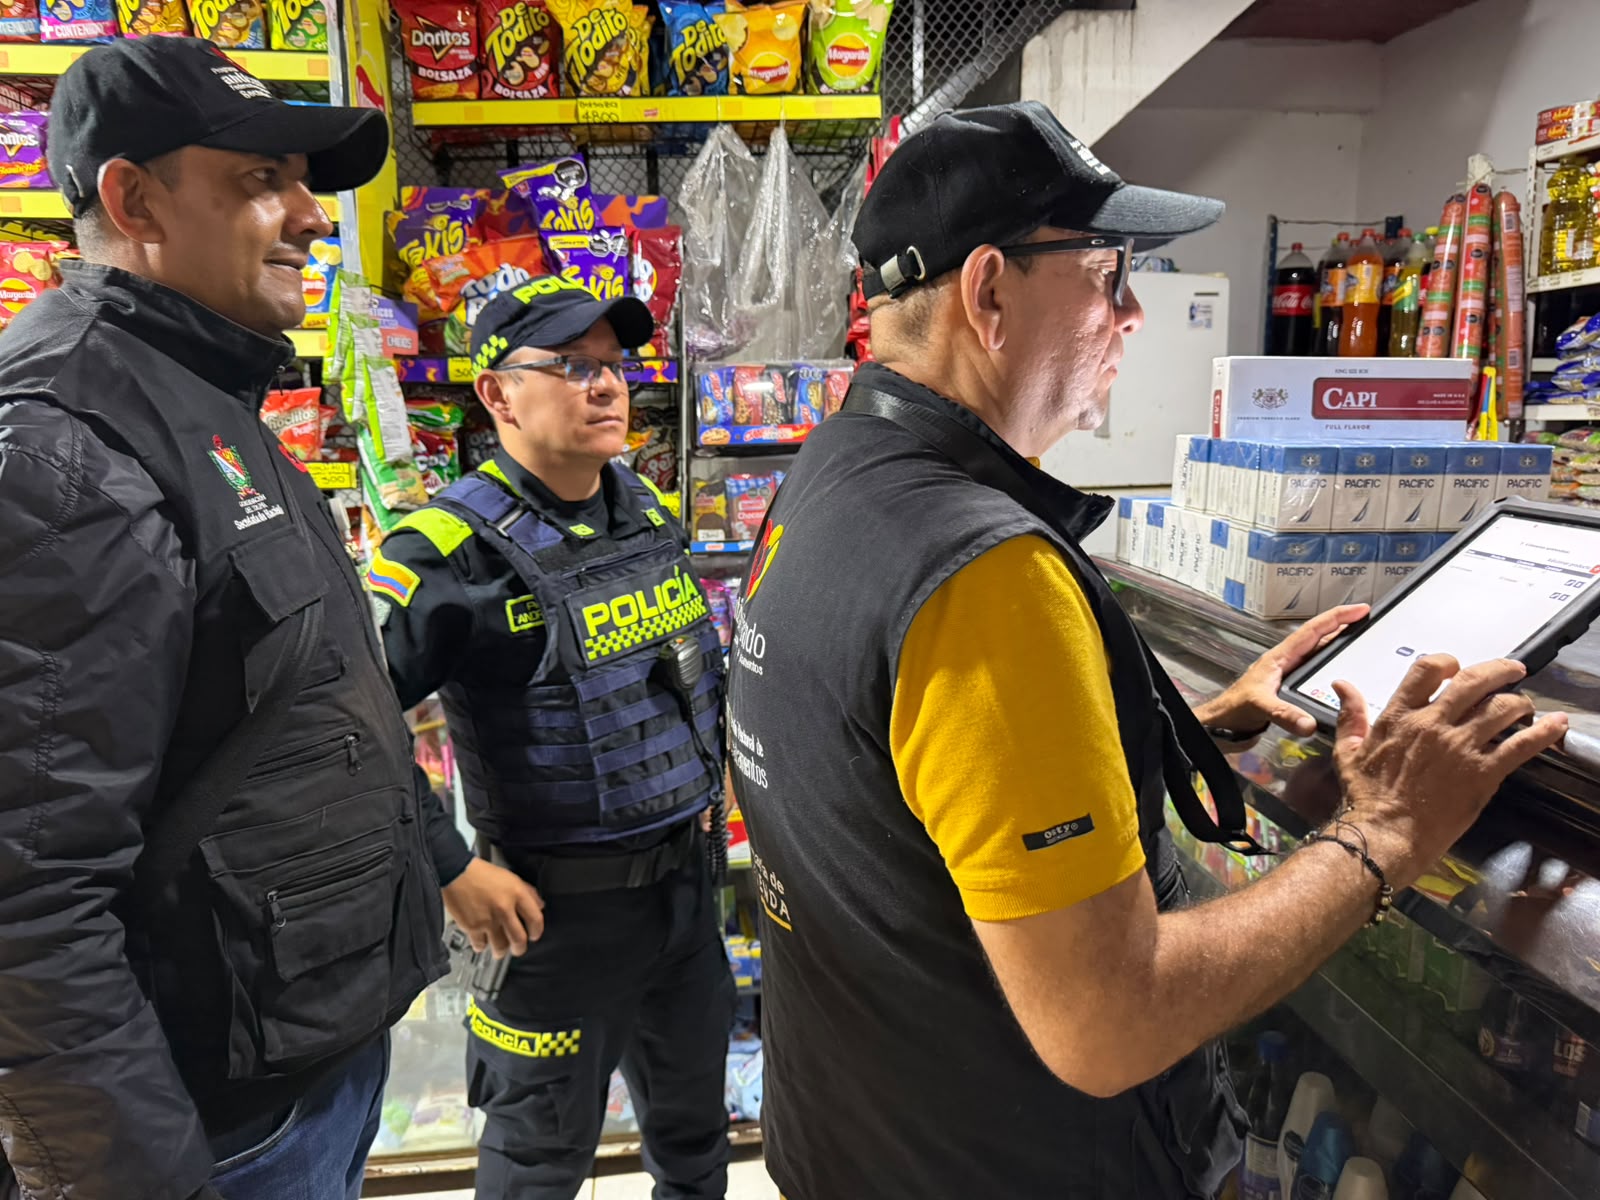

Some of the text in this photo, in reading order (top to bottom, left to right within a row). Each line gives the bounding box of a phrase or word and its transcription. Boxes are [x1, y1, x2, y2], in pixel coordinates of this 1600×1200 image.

[411, 29, 471, 47] Doritos
[485, 6, 551, 72] Todito
[565, 9, 628, 77] Todito
[827, 48, 871, 63] Margarita
[417, 66, 473, 82] BOLSAZA
[1322, 387, 1378, 410] CAPI
[1344, 478, 1381, 489] PACIFIC
[1398, 478, 1435, 489] PACIFIC
[1453, 478, 1490, 489] PACIFIC
[1507, 478, 1543, 489] PACIFIC
[1277, 567, 1314, 577] PACIFIC
[1330, 566, 1367, 576] PACIFIC
[582, 564, 700, 637] POLICÍA
